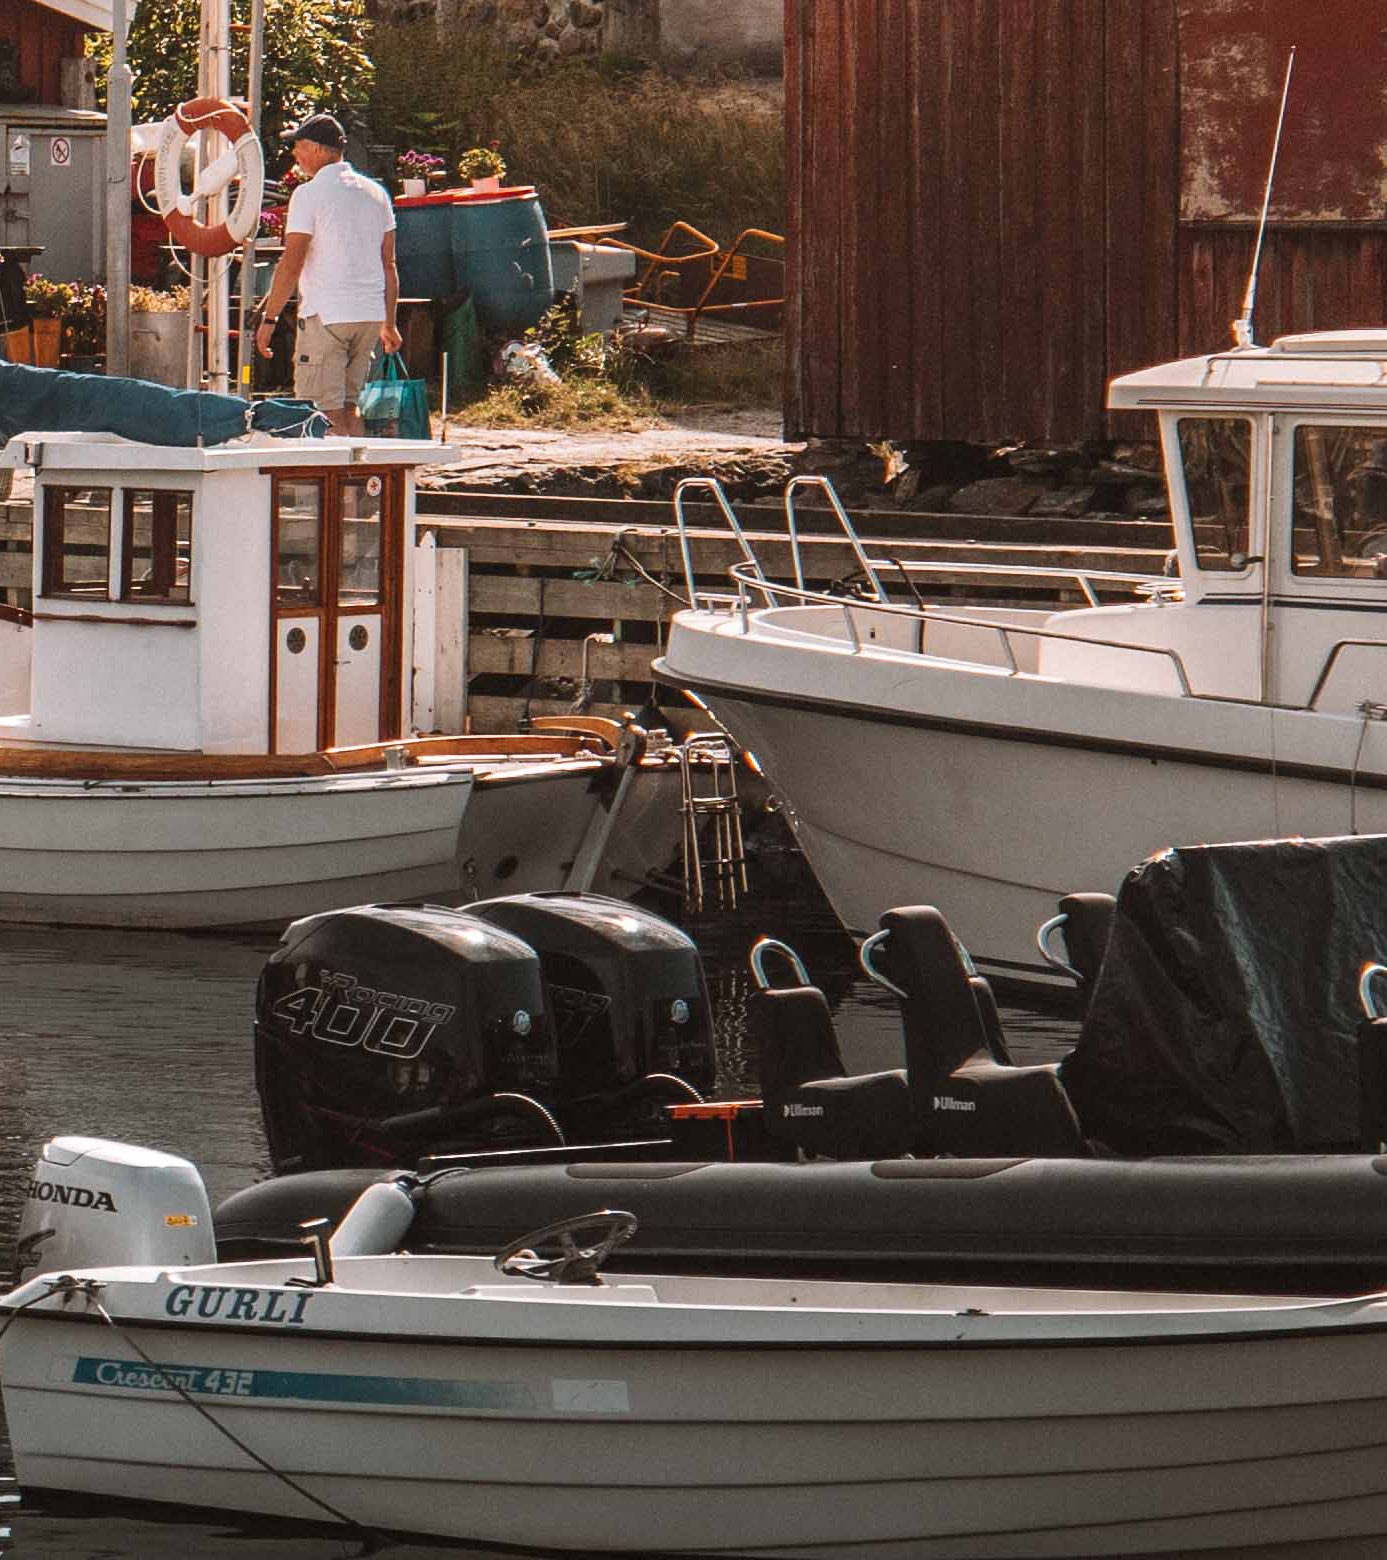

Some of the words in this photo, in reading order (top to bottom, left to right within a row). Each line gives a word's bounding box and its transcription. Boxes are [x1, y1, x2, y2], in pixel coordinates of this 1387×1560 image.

[274, 986, 437, 1059] 400
[941, 1097, 976, 1112] Ullman
[27, 1181, 118, 1213] HONDA
[165, 1285, 314, 1324] GURLI
[96, 1361, 203, 1392] Crescent
[203, 1369, 254, 1396] 432
